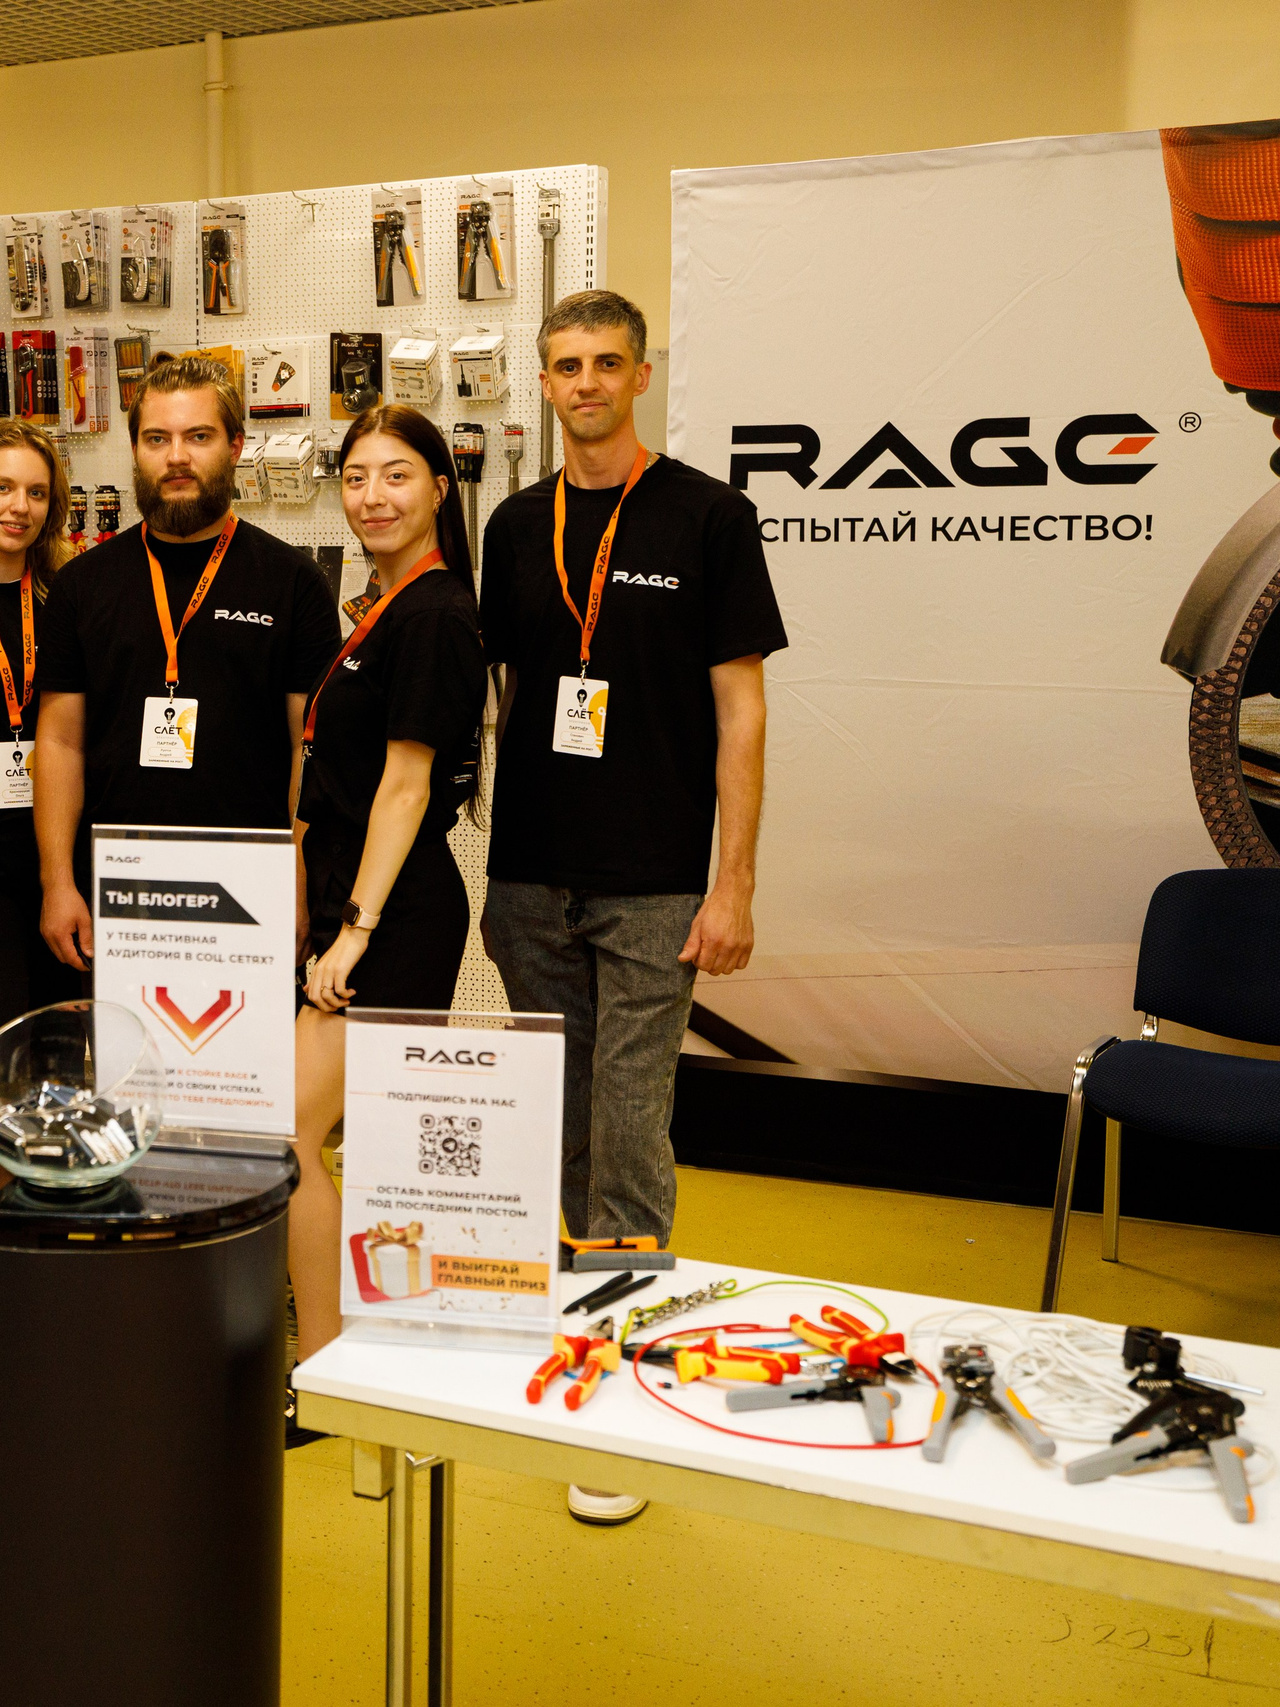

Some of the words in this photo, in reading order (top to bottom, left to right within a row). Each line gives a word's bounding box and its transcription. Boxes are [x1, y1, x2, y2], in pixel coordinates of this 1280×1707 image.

[729, 413, 1160, 491] RAGE
[930, 514, 1153, 543] КАЧЕСТВО!
[211, 534, 228, 563] RAGE
[597, 535, 610, 574] RAGE
[613, 571, 680, 589] RAGE
[191, 577, 209, 608] RAGE
[214, 609, 274, 626] RAGE
[588, 592, 599, 631] RAGE
[3, 668, 14, 701] RAGE
[105, 891, 133, 905] ТЫ
[138, 892, 220, 909] БЛОГЕР?
[107, 931, 114, 941] У
[118, 932, 147, 942] ТЕБЯ
[151, 933, 217, 945] АКТИВНАЯ
[106, 949, 180, 961] АУДИТОРИЯ
[185, 952, 192, 961] В
[229, 954, 275, 965] СЕТЯХ?
[387, 1091, 467, 1105] ПОДПИШИСЬ
[470, 1096, 488, 1107] НА
[492, 1098, 517, 1108] НАС
[376, 1185, 424, 1197] ОСТАВЬ
[427, 1189, 522, 1204] КОММЕНТАРИЙ
[366, 1199, 392, 1209] ПОД
[395, 1201, 472, 1215] ПОСЛЕДНИМ
[476, 1207, 528, 1218] ПОСТОМ
[438, 1261, 448, 1270] И
[451, 1260, 519, 1275] ВЫИГРАЙ
[437, 1274, 507, 1288] ГЛАВНЫЙ
[510, 1281, 547, 1292] ПРИЗ
